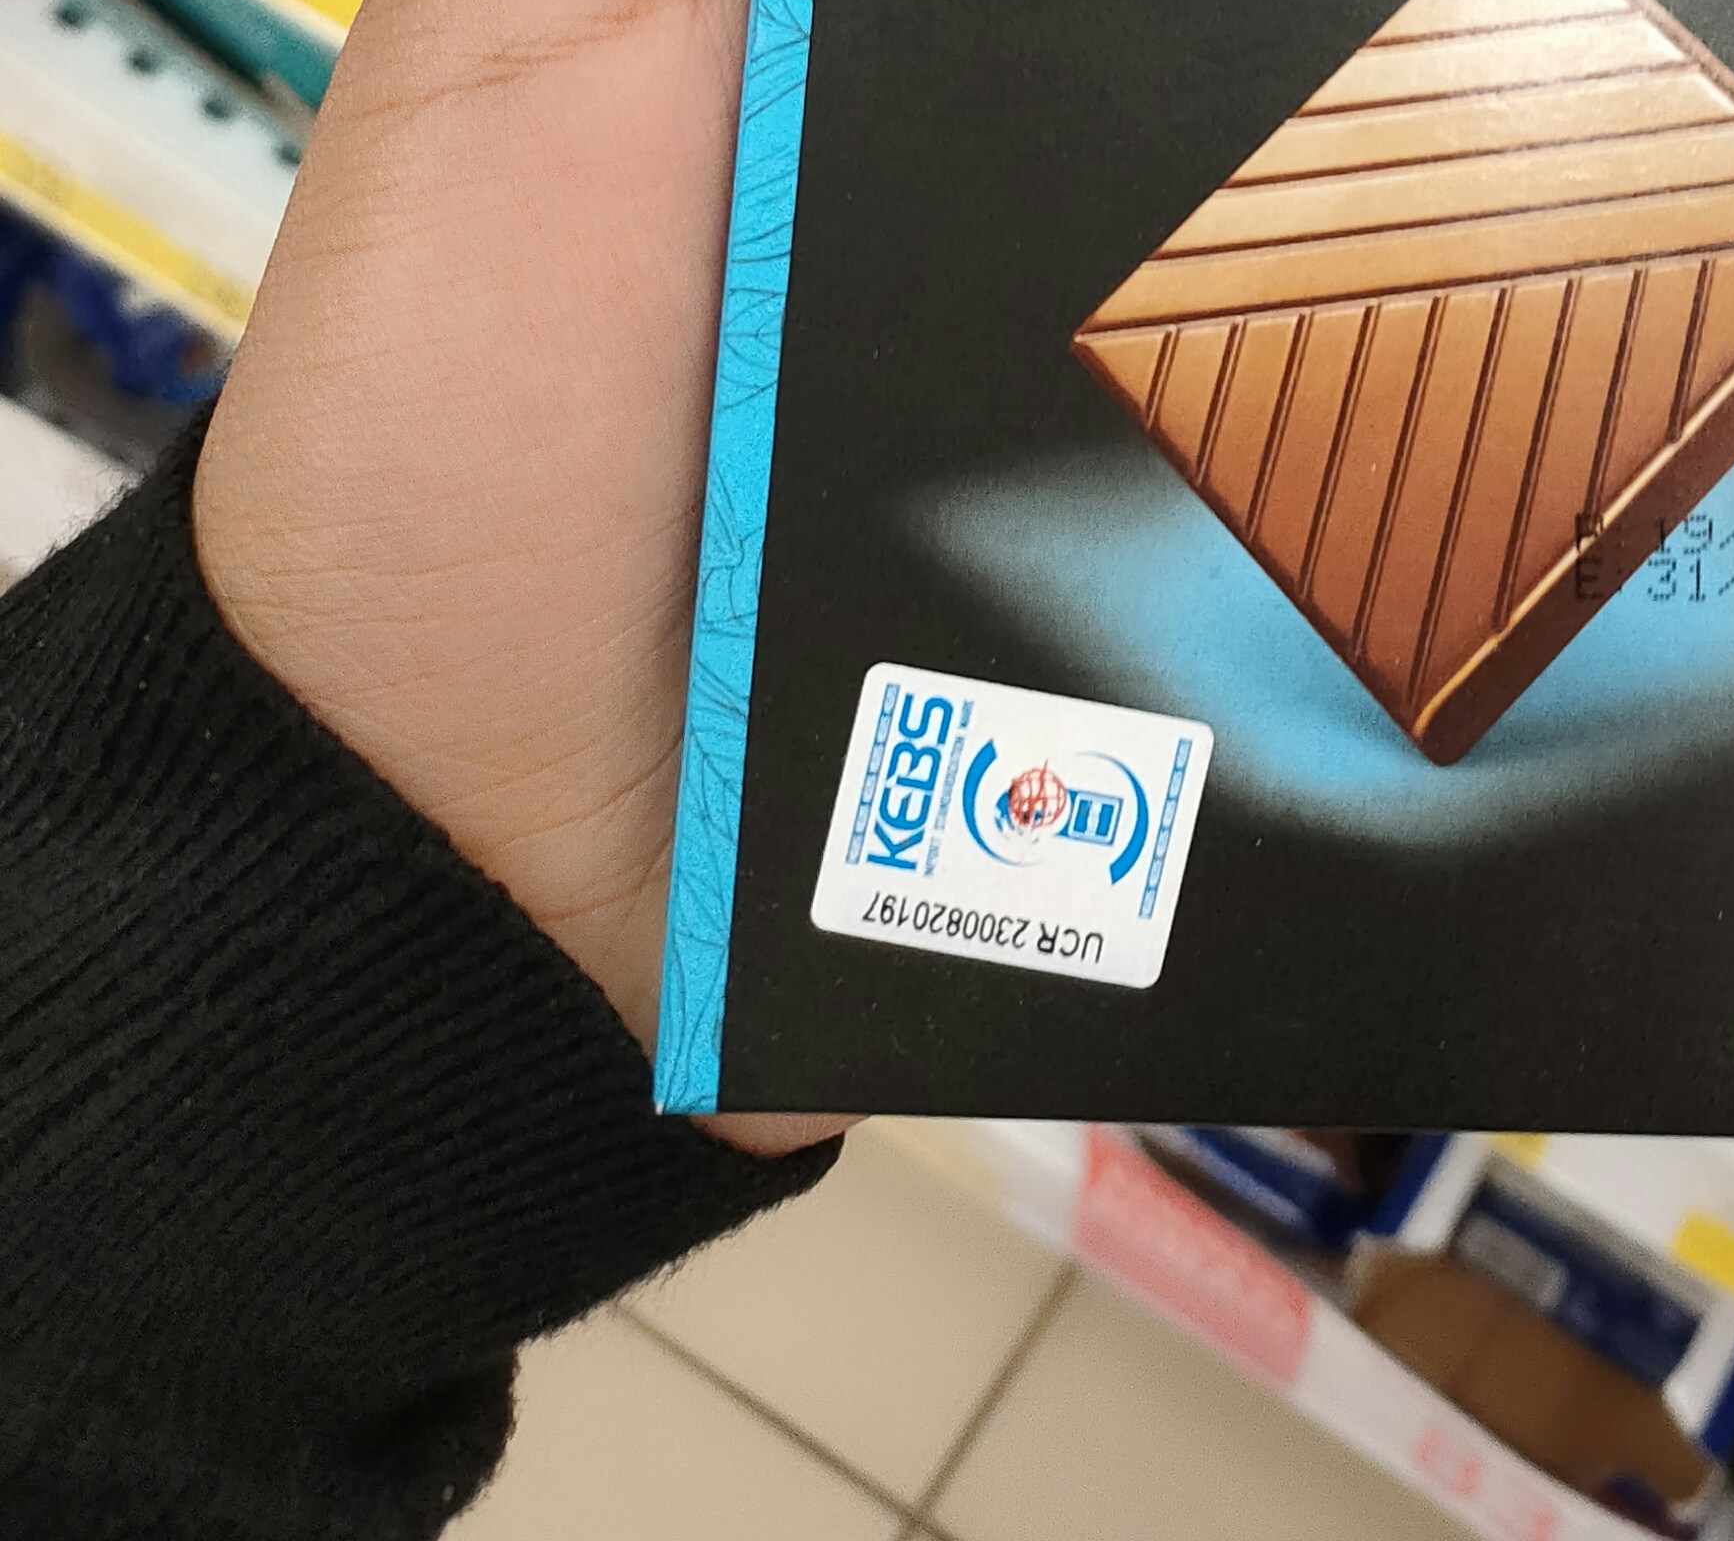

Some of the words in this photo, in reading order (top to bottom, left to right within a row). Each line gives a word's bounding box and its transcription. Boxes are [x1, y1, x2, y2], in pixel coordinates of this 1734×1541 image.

[866, 692, 954, 871] KEBS
[862, 891, 1031, 948] 2300820197
[1038, 922, 1105, 964] UCR
